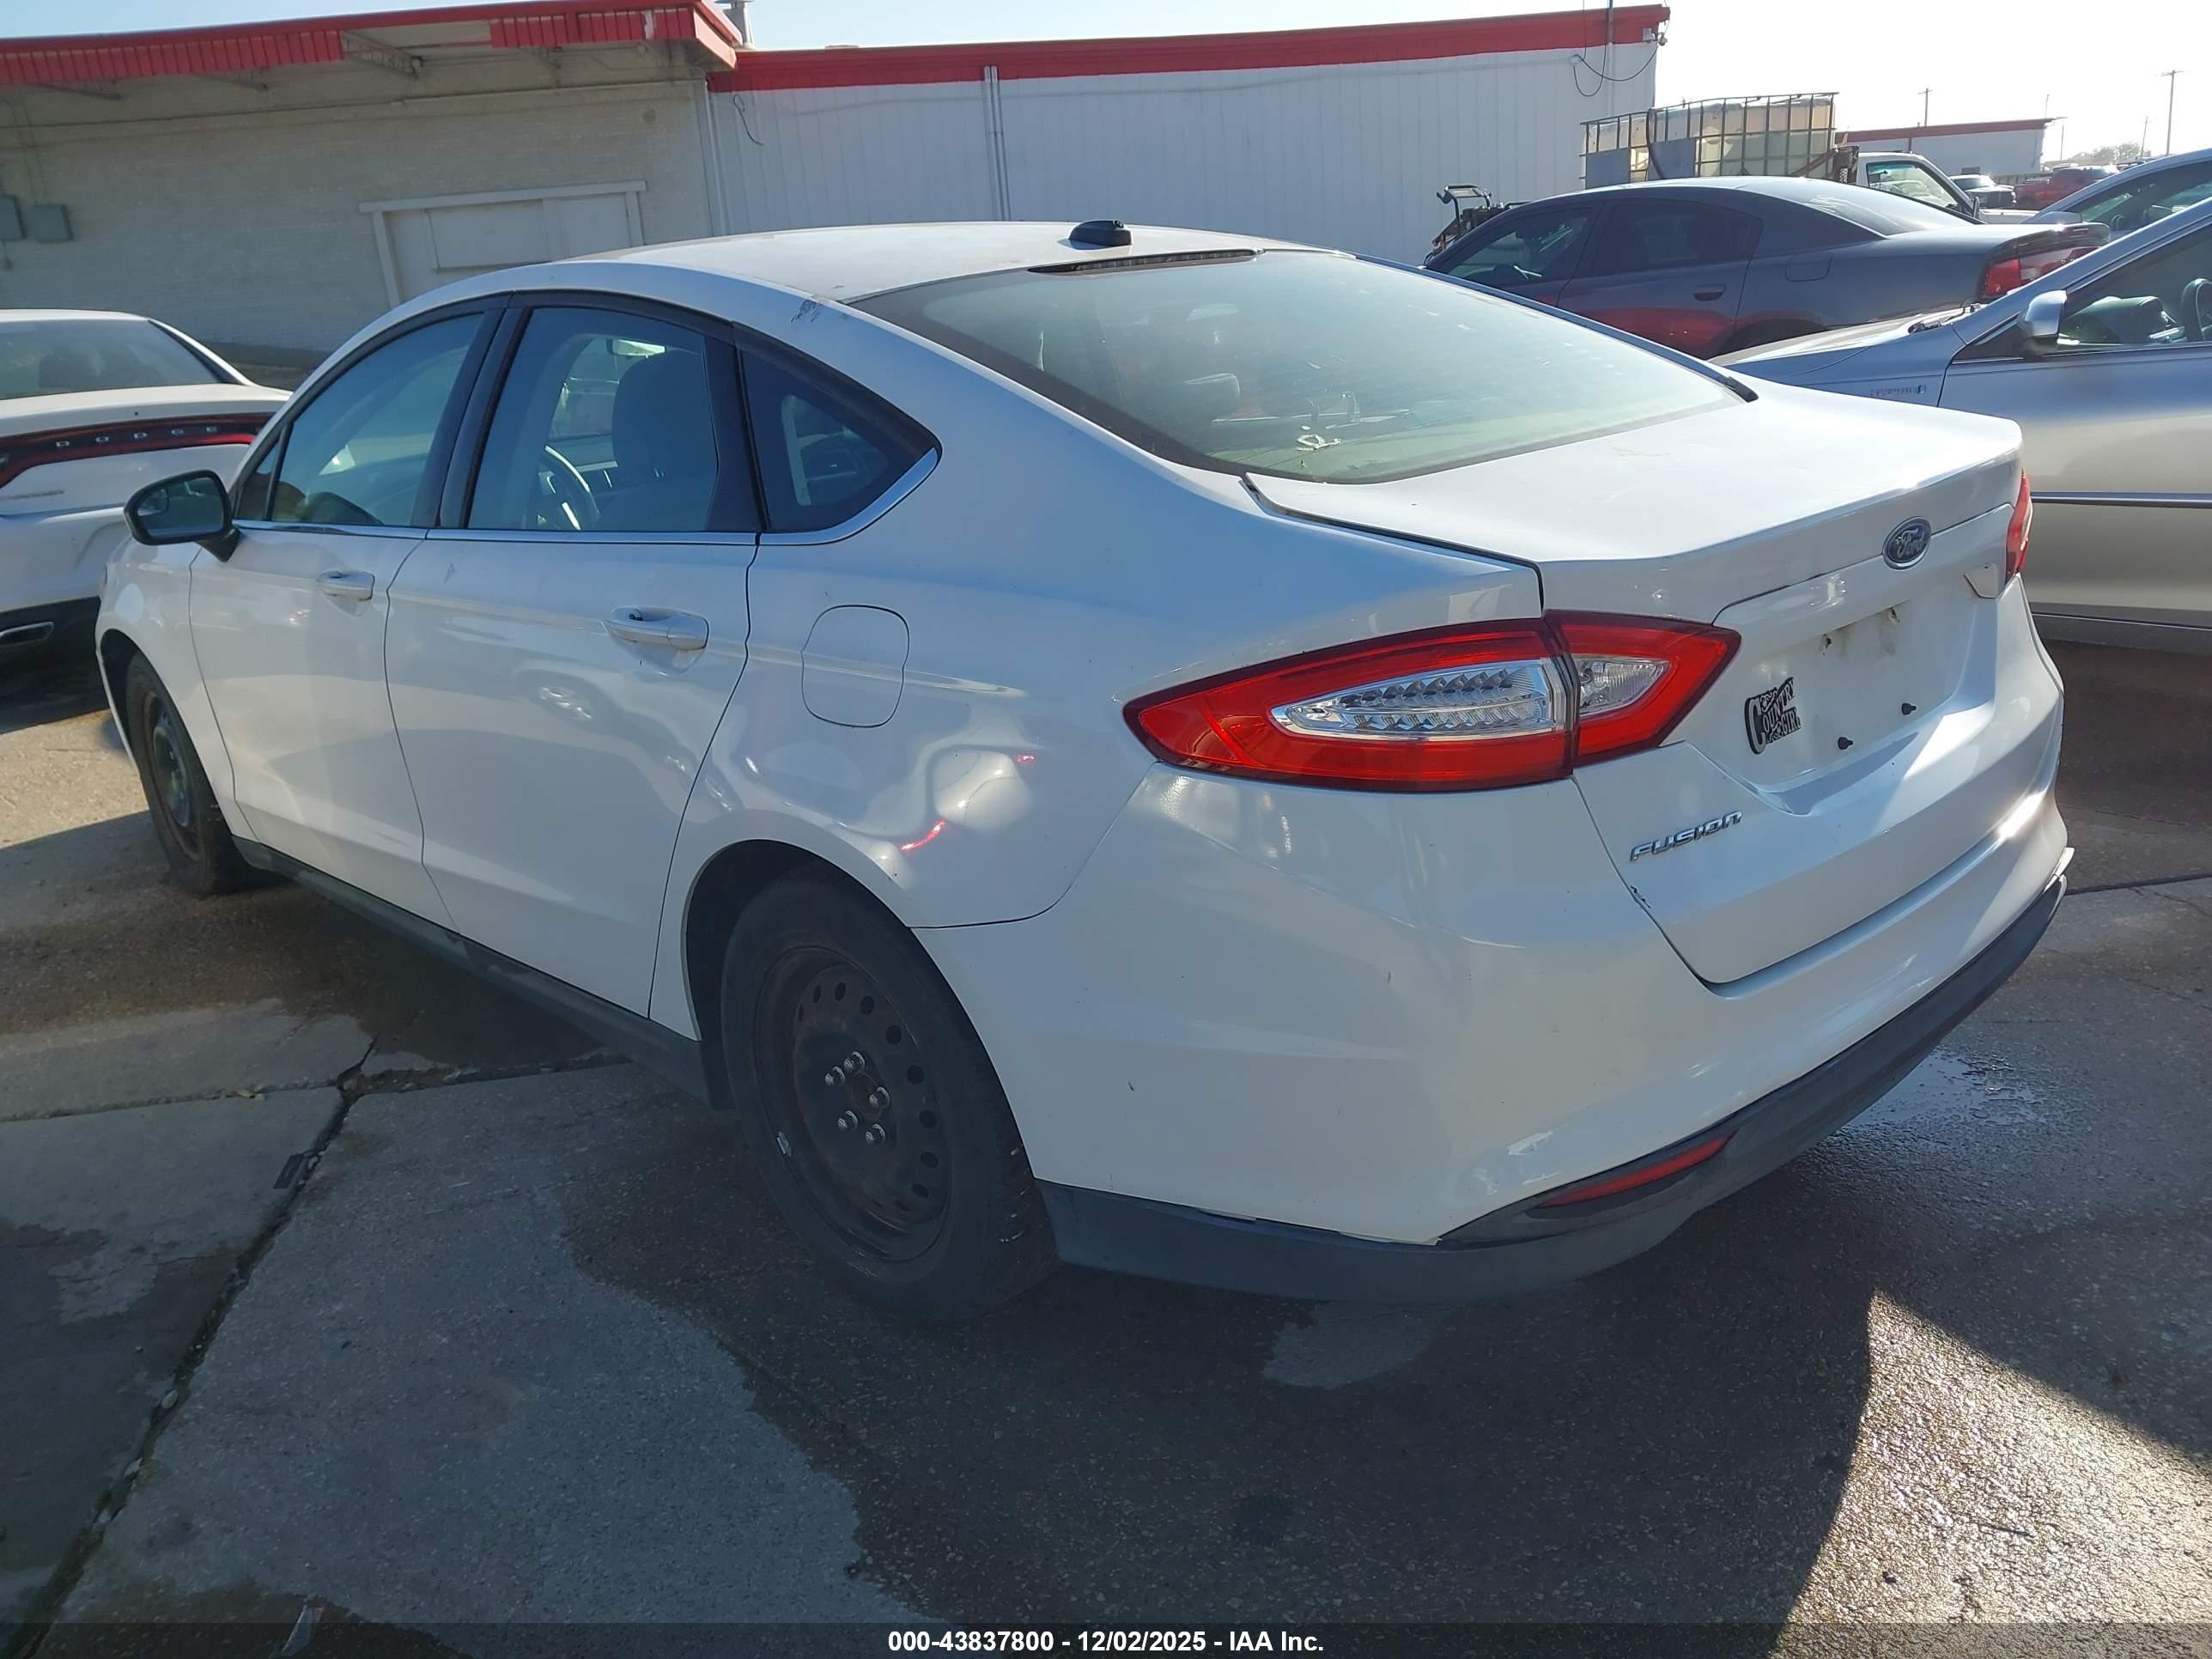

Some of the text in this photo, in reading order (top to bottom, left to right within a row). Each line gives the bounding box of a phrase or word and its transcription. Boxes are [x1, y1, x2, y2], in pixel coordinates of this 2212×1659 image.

[55, 426, 218, 447] DODGE
[1893, 525, 1925, 559] Ford
[1745, 677, 1796, 754] COUNTRY
[1631, 810, 1742, 861] FUSION
